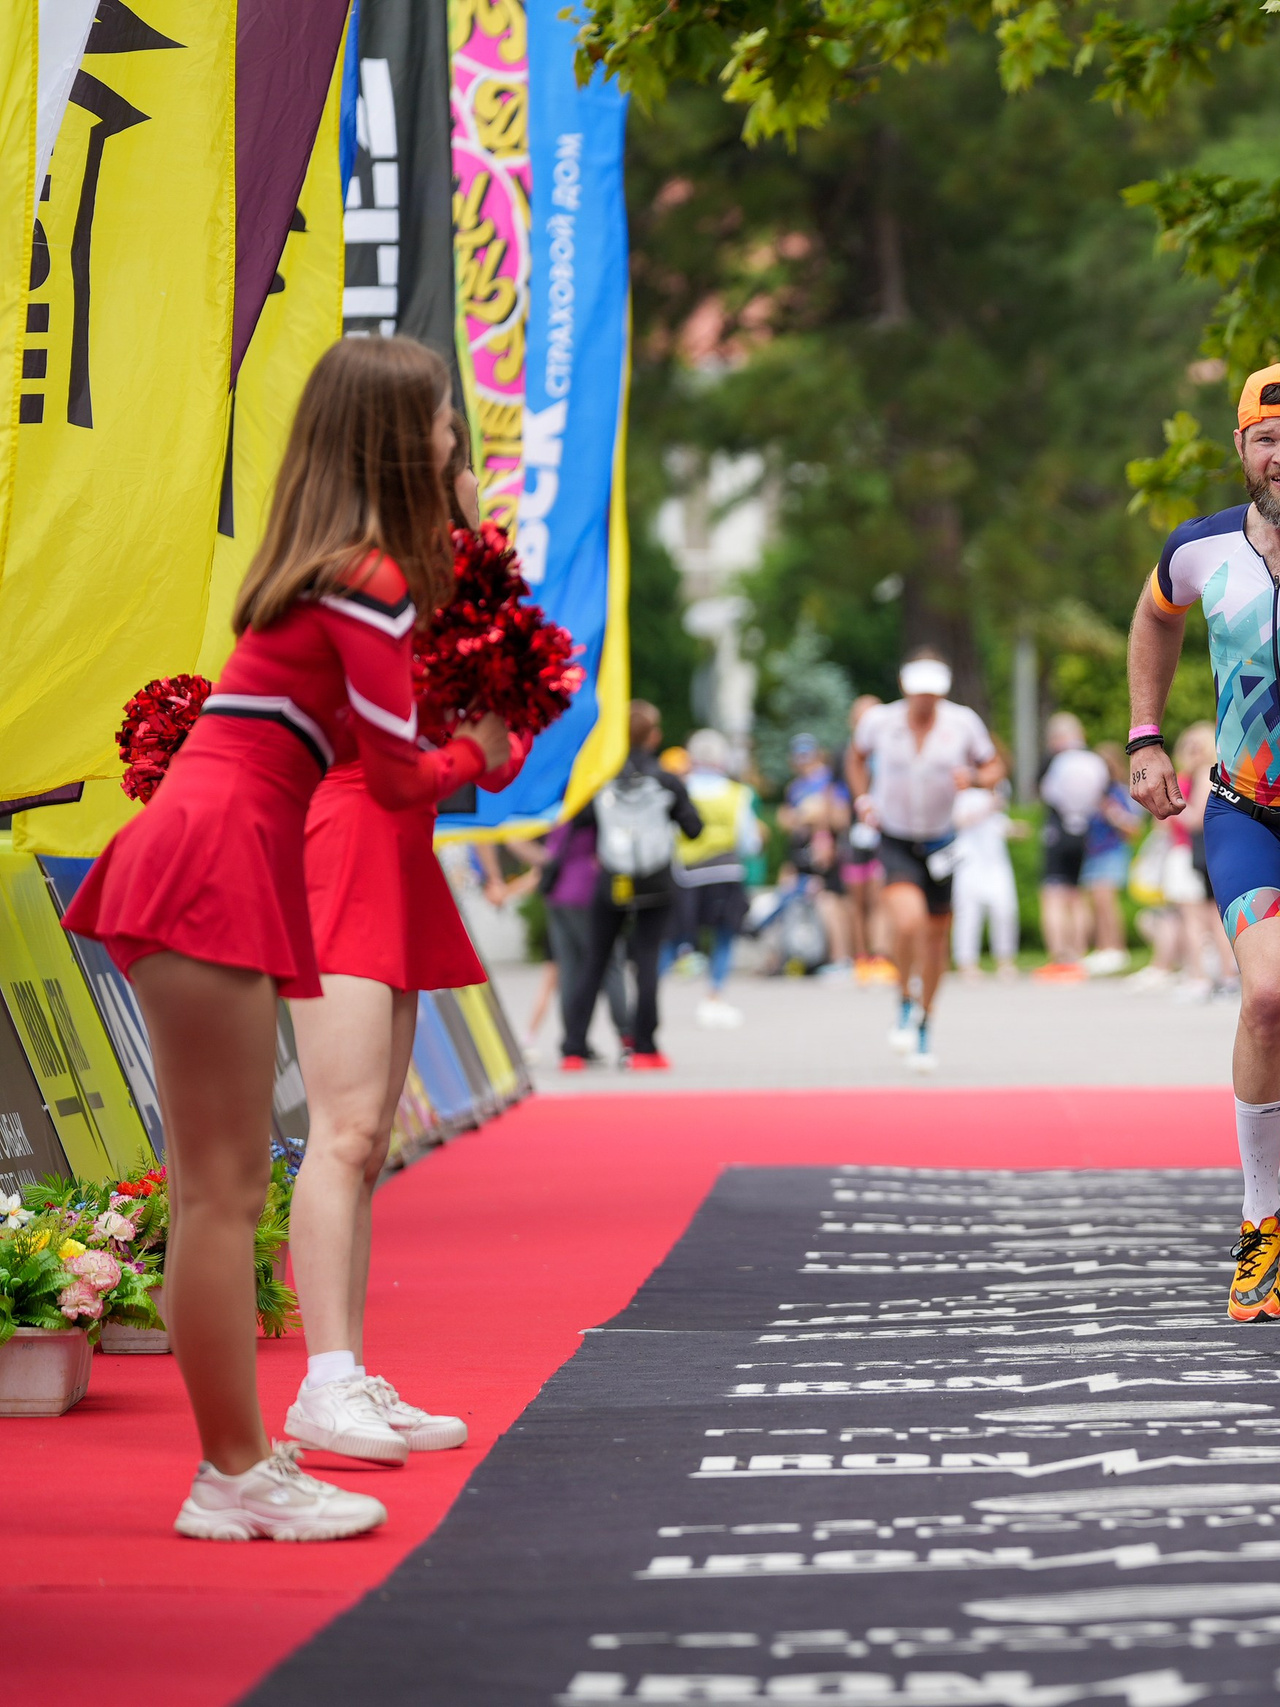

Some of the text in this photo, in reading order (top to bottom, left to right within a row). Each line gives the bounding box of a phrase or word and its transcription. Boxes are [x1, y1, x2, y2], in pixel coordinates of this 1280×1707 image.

[551, 132, 583, 212] ДОМ
[545, 214, 575, 398] СТРАХОВОЙ
[728, 1375, 1023, 1393] IRON
[697, 1451, 1030, 1471] IRON
[646, 1546, 1033, 1575] IRON
[564, 1670, 1033, 1703] IRON
